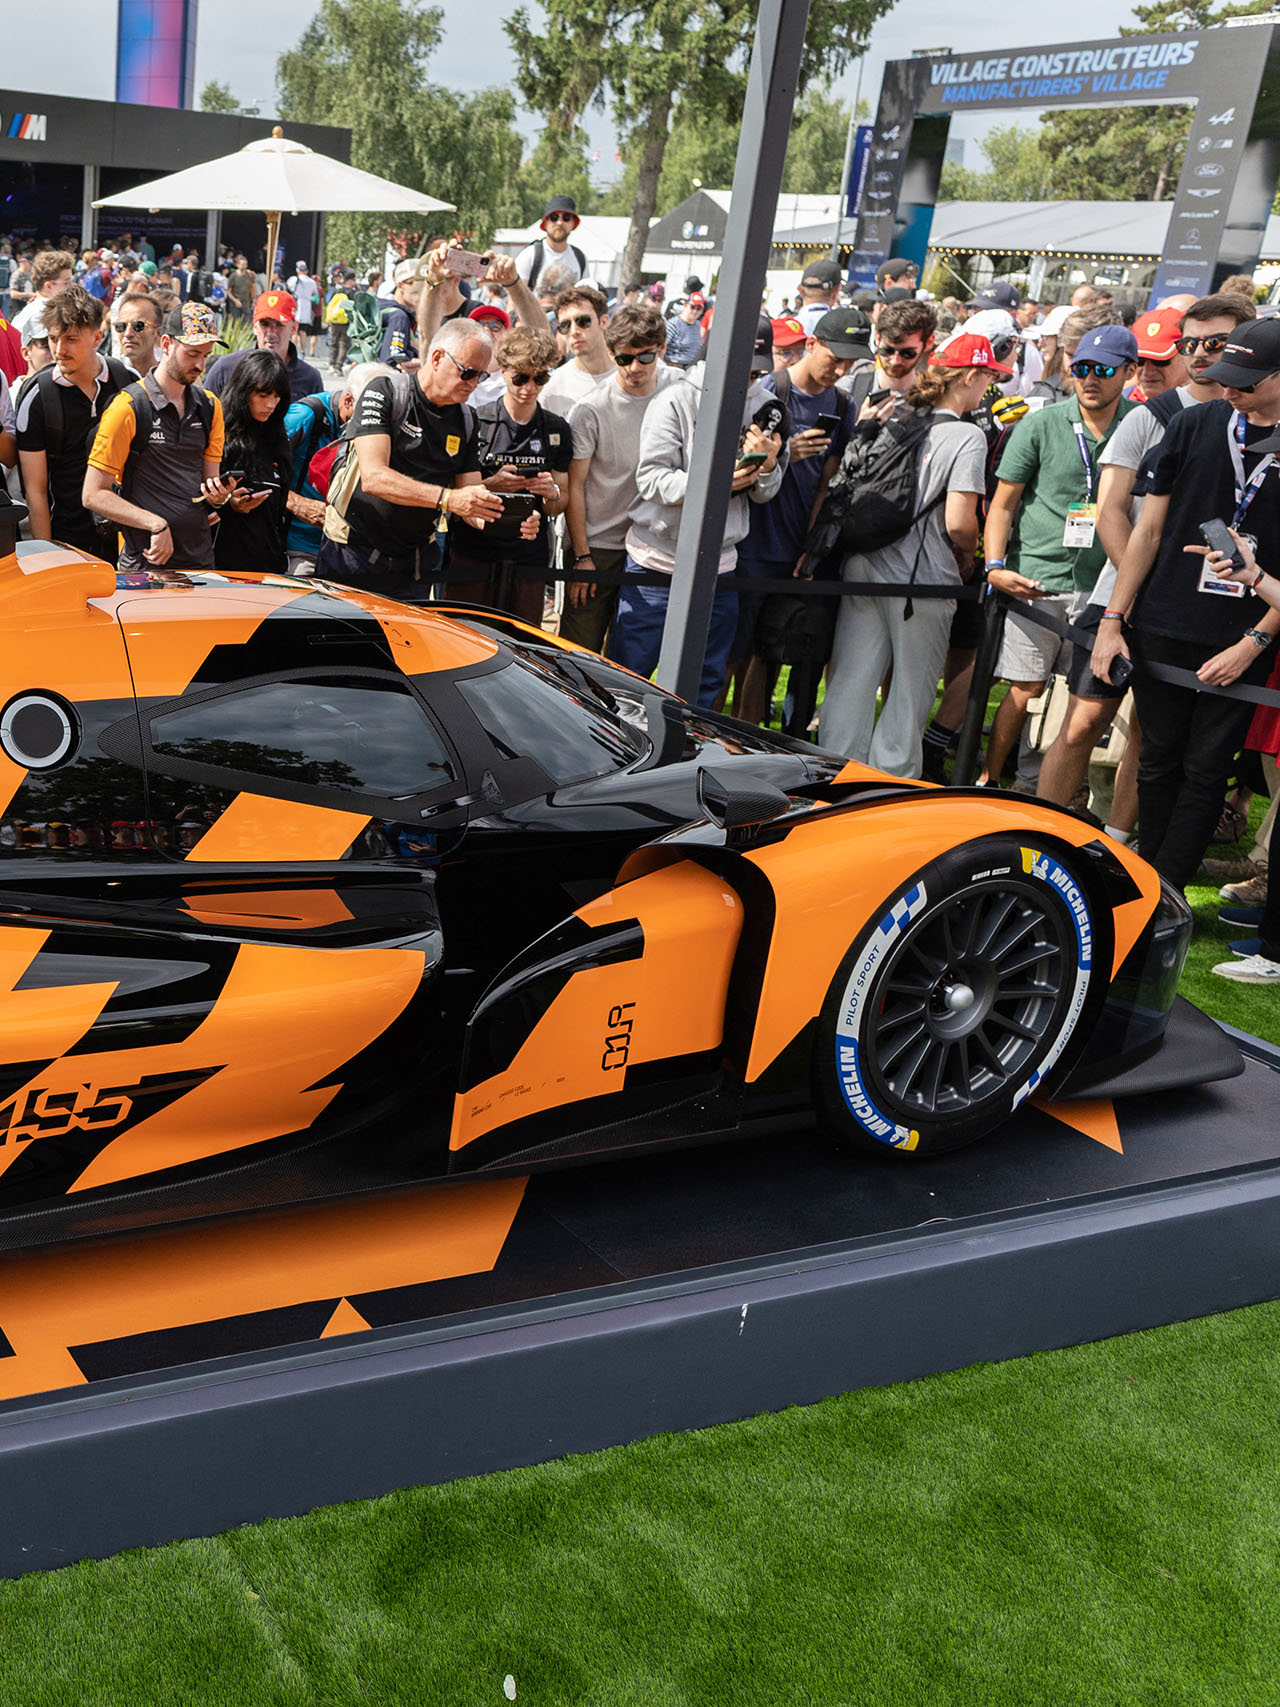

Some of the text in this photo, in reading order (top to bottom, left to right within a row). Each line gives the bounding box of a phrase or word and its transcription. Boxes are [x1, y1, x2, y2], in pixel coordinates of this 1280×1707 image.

[930, 40, 1199, 85] VILLAGE CONSTRUCTEURS
[942, 70, 1169, 103] MANUFACTURERS' VILLAGE
[1049, 867, 1092, 961] MICHELIN
[845, 944, 881, 1026] PILOT SPORT
[1055, 980, 1087, 1056] PILOT SPORT
[840, 1046, 893, 1137] MICHELIN
